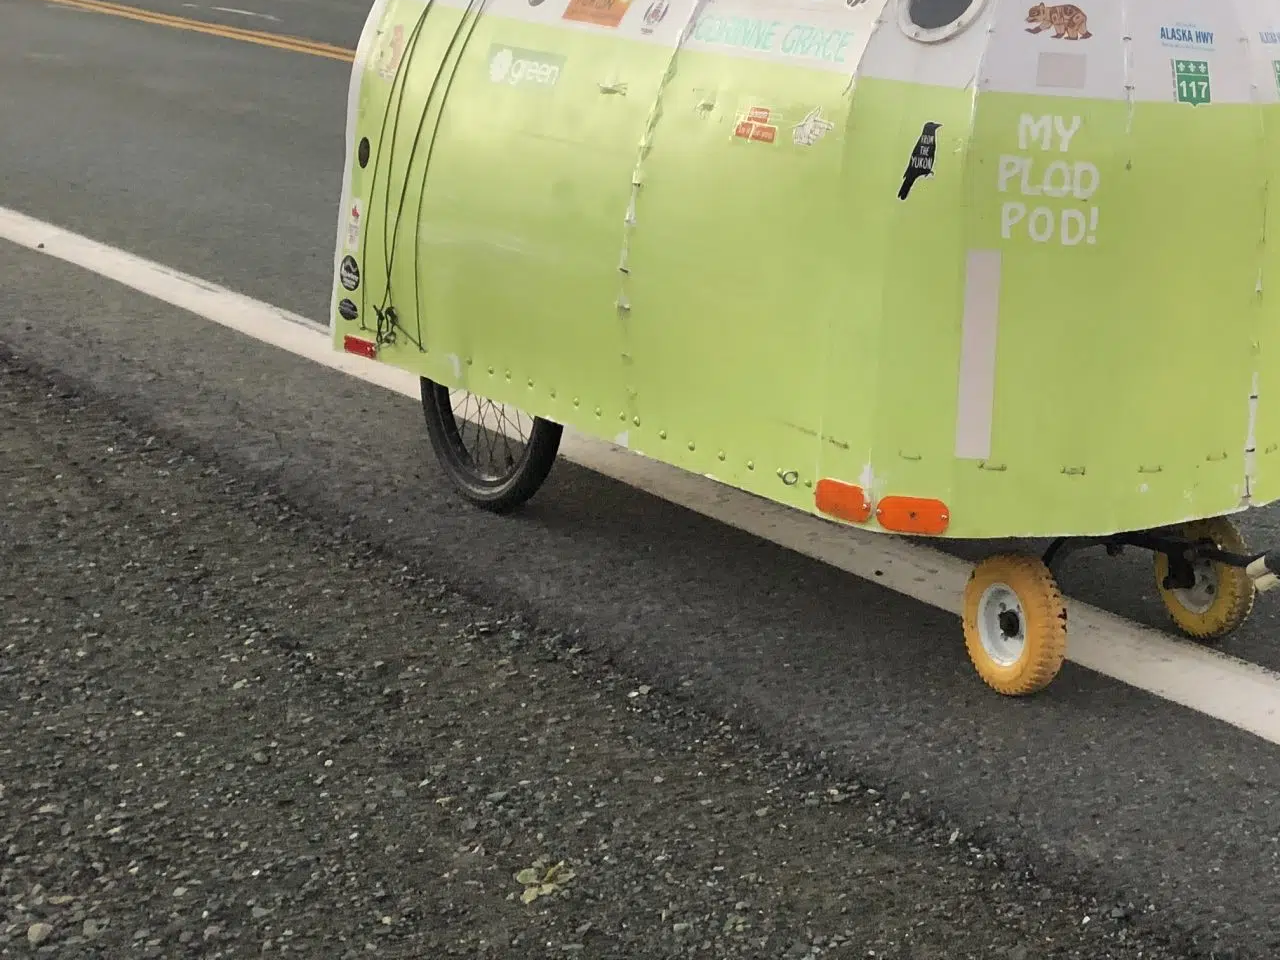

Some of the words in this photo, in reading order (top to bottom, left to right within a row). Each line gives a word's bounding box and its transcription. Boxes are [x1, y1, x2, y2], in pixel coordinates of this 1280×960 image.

[781, 23, 854, 63] GRACE
[1160, 26, 1194, 43] ALASKA
[1195, 30, 1214, 45] HWY
[510, 56, 560, 85] green
[1179, 80, 1208, 99] 117
[920, 134, 935, 144] FROM
[1018, 112, 1081, 152] MY
[919, 145, 930, 155] THE
[911, 156, 933, 170] YUKON
[998, 154, 1099, 199] PLOD
[1001, 201, 1100, 246] POD!
